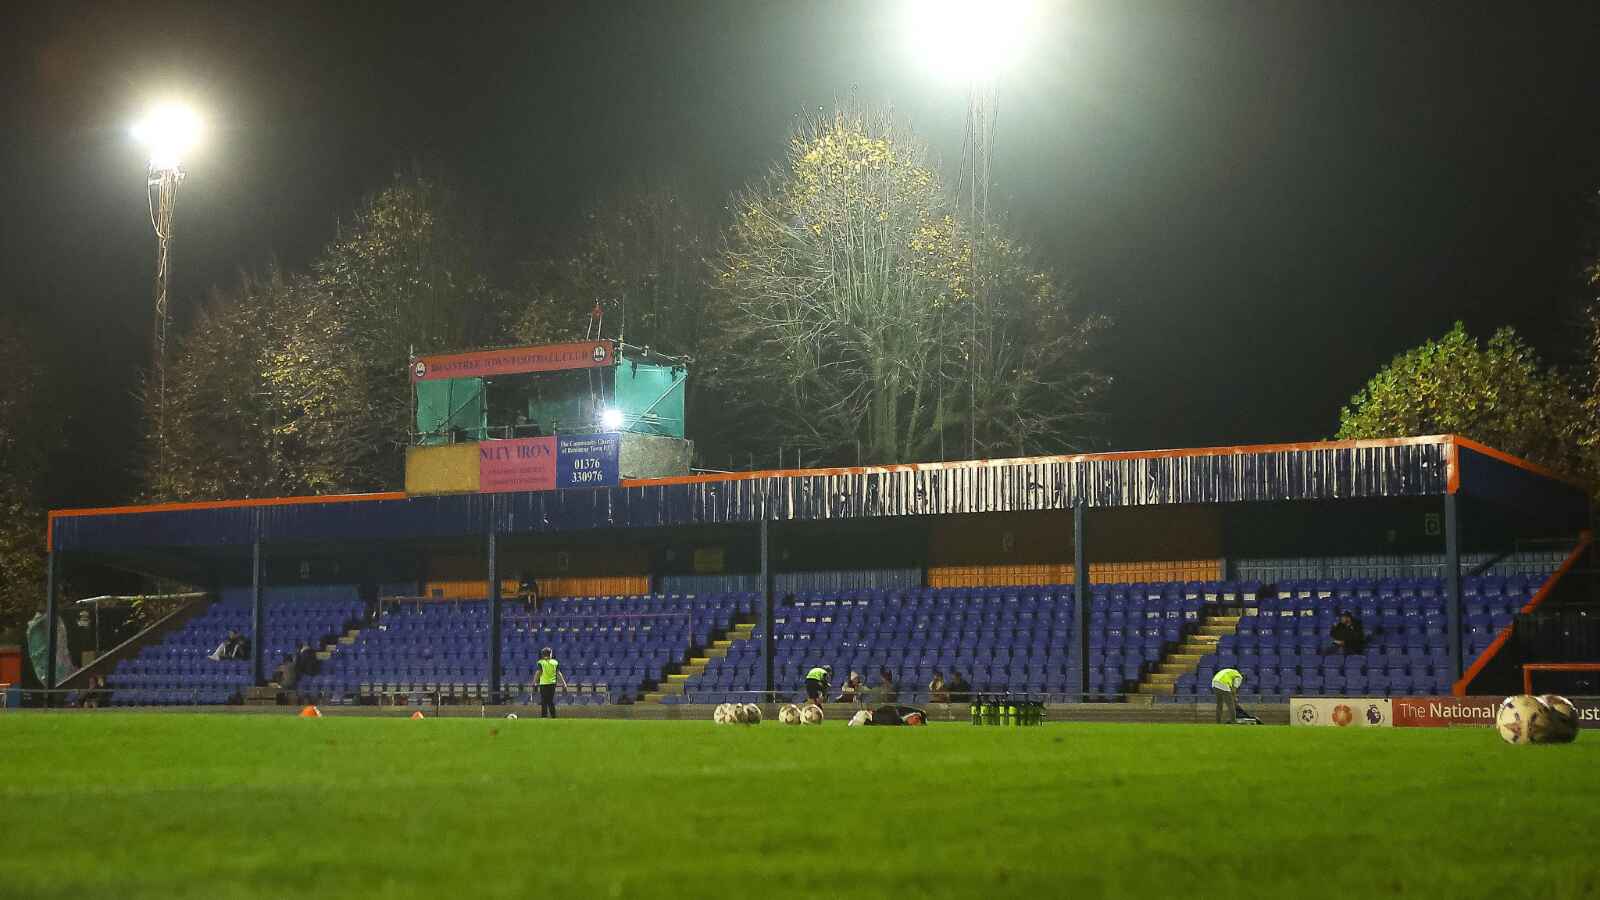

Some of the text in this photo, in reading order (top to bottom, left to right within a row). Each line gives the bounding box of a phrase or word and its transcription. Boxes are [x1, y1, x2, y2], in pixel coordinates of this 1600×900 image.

[516, 445, 552, 459] IRON
[574, 458, 600, 469] 01376
[570, 471, 603, 482] 330976
[1400, 703, 1600, 721] The National ust
